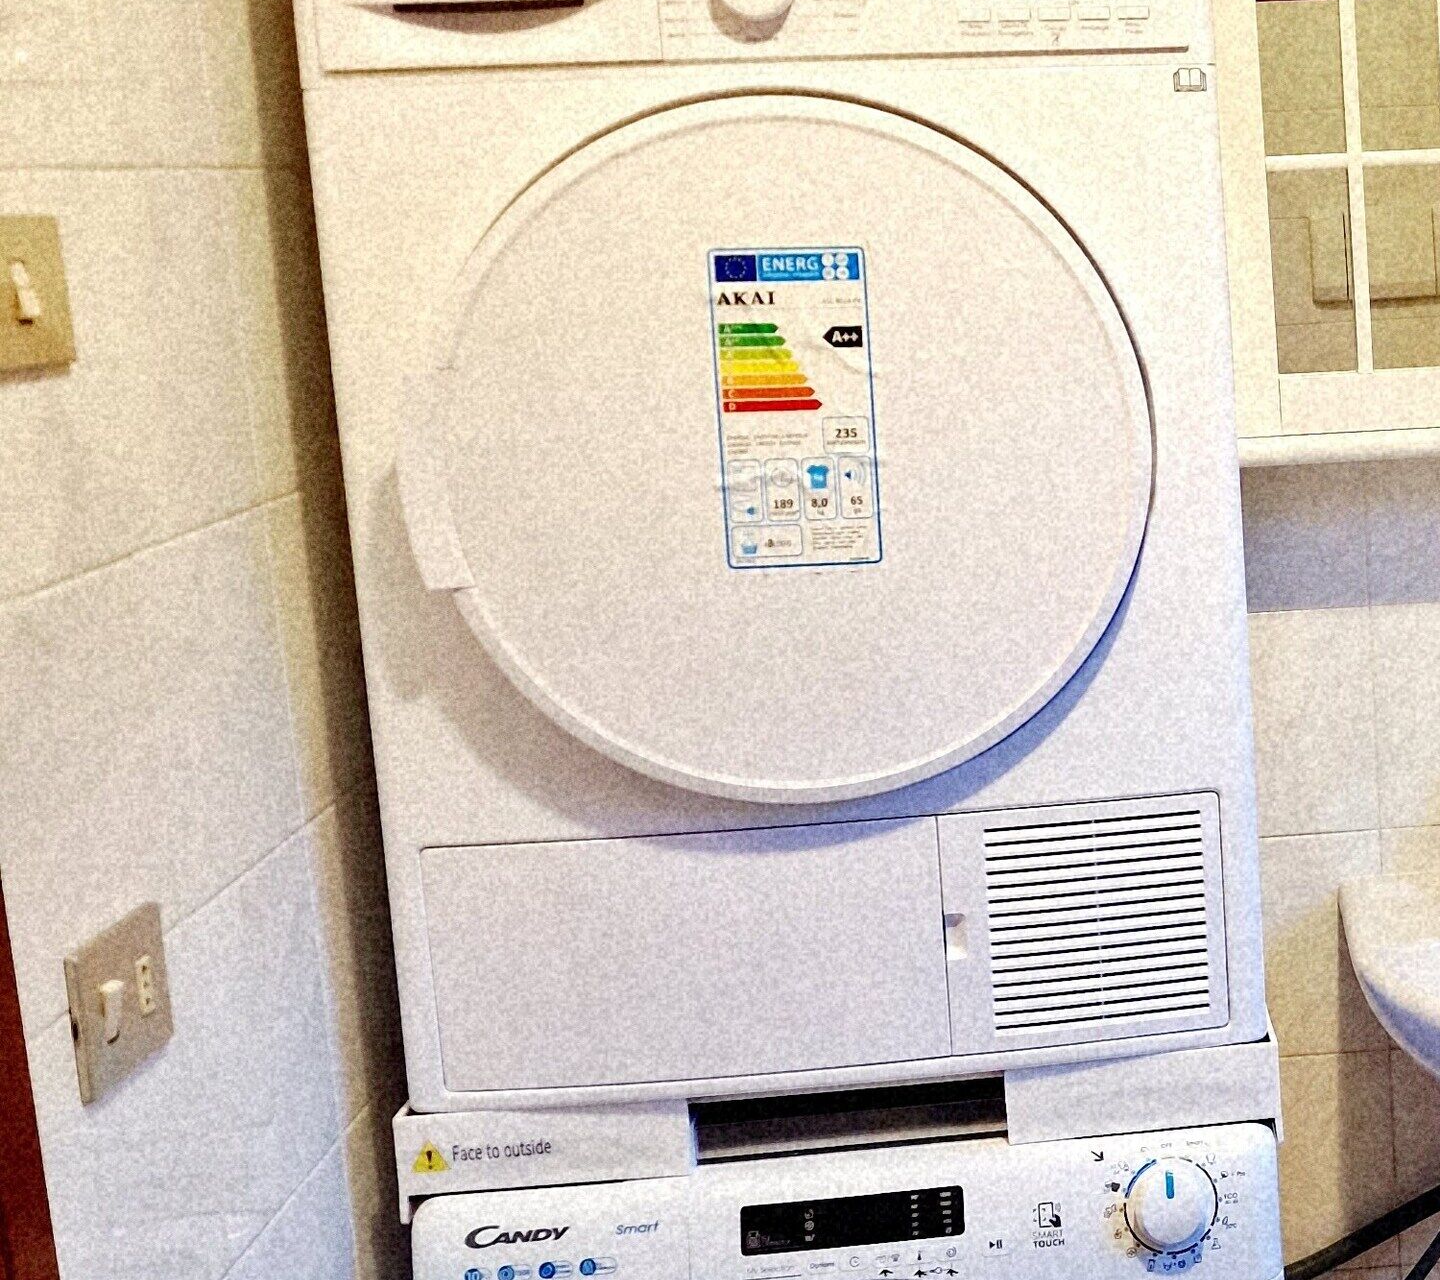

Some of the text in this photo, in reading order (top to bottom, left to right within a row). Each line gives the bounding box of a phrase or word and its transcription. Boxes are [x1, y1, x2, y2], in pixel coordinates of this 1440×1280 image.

[762, 257, 819, 272] ENERG
[716, 290, 776, 306] AKAI
[831, 330, 859, 344] A++
[834, 427, 858, 439] 235
[773, 498, 795, 510] 189
[850, 496, 864, 507] 65
[451, 1138, 553, 1163] Face to outside
[614, 1219, 661, 1236] Smart
[1032, 1229, 1063, 1240] SMART
[1032, 1238, 1066, 1249] TOUCH
